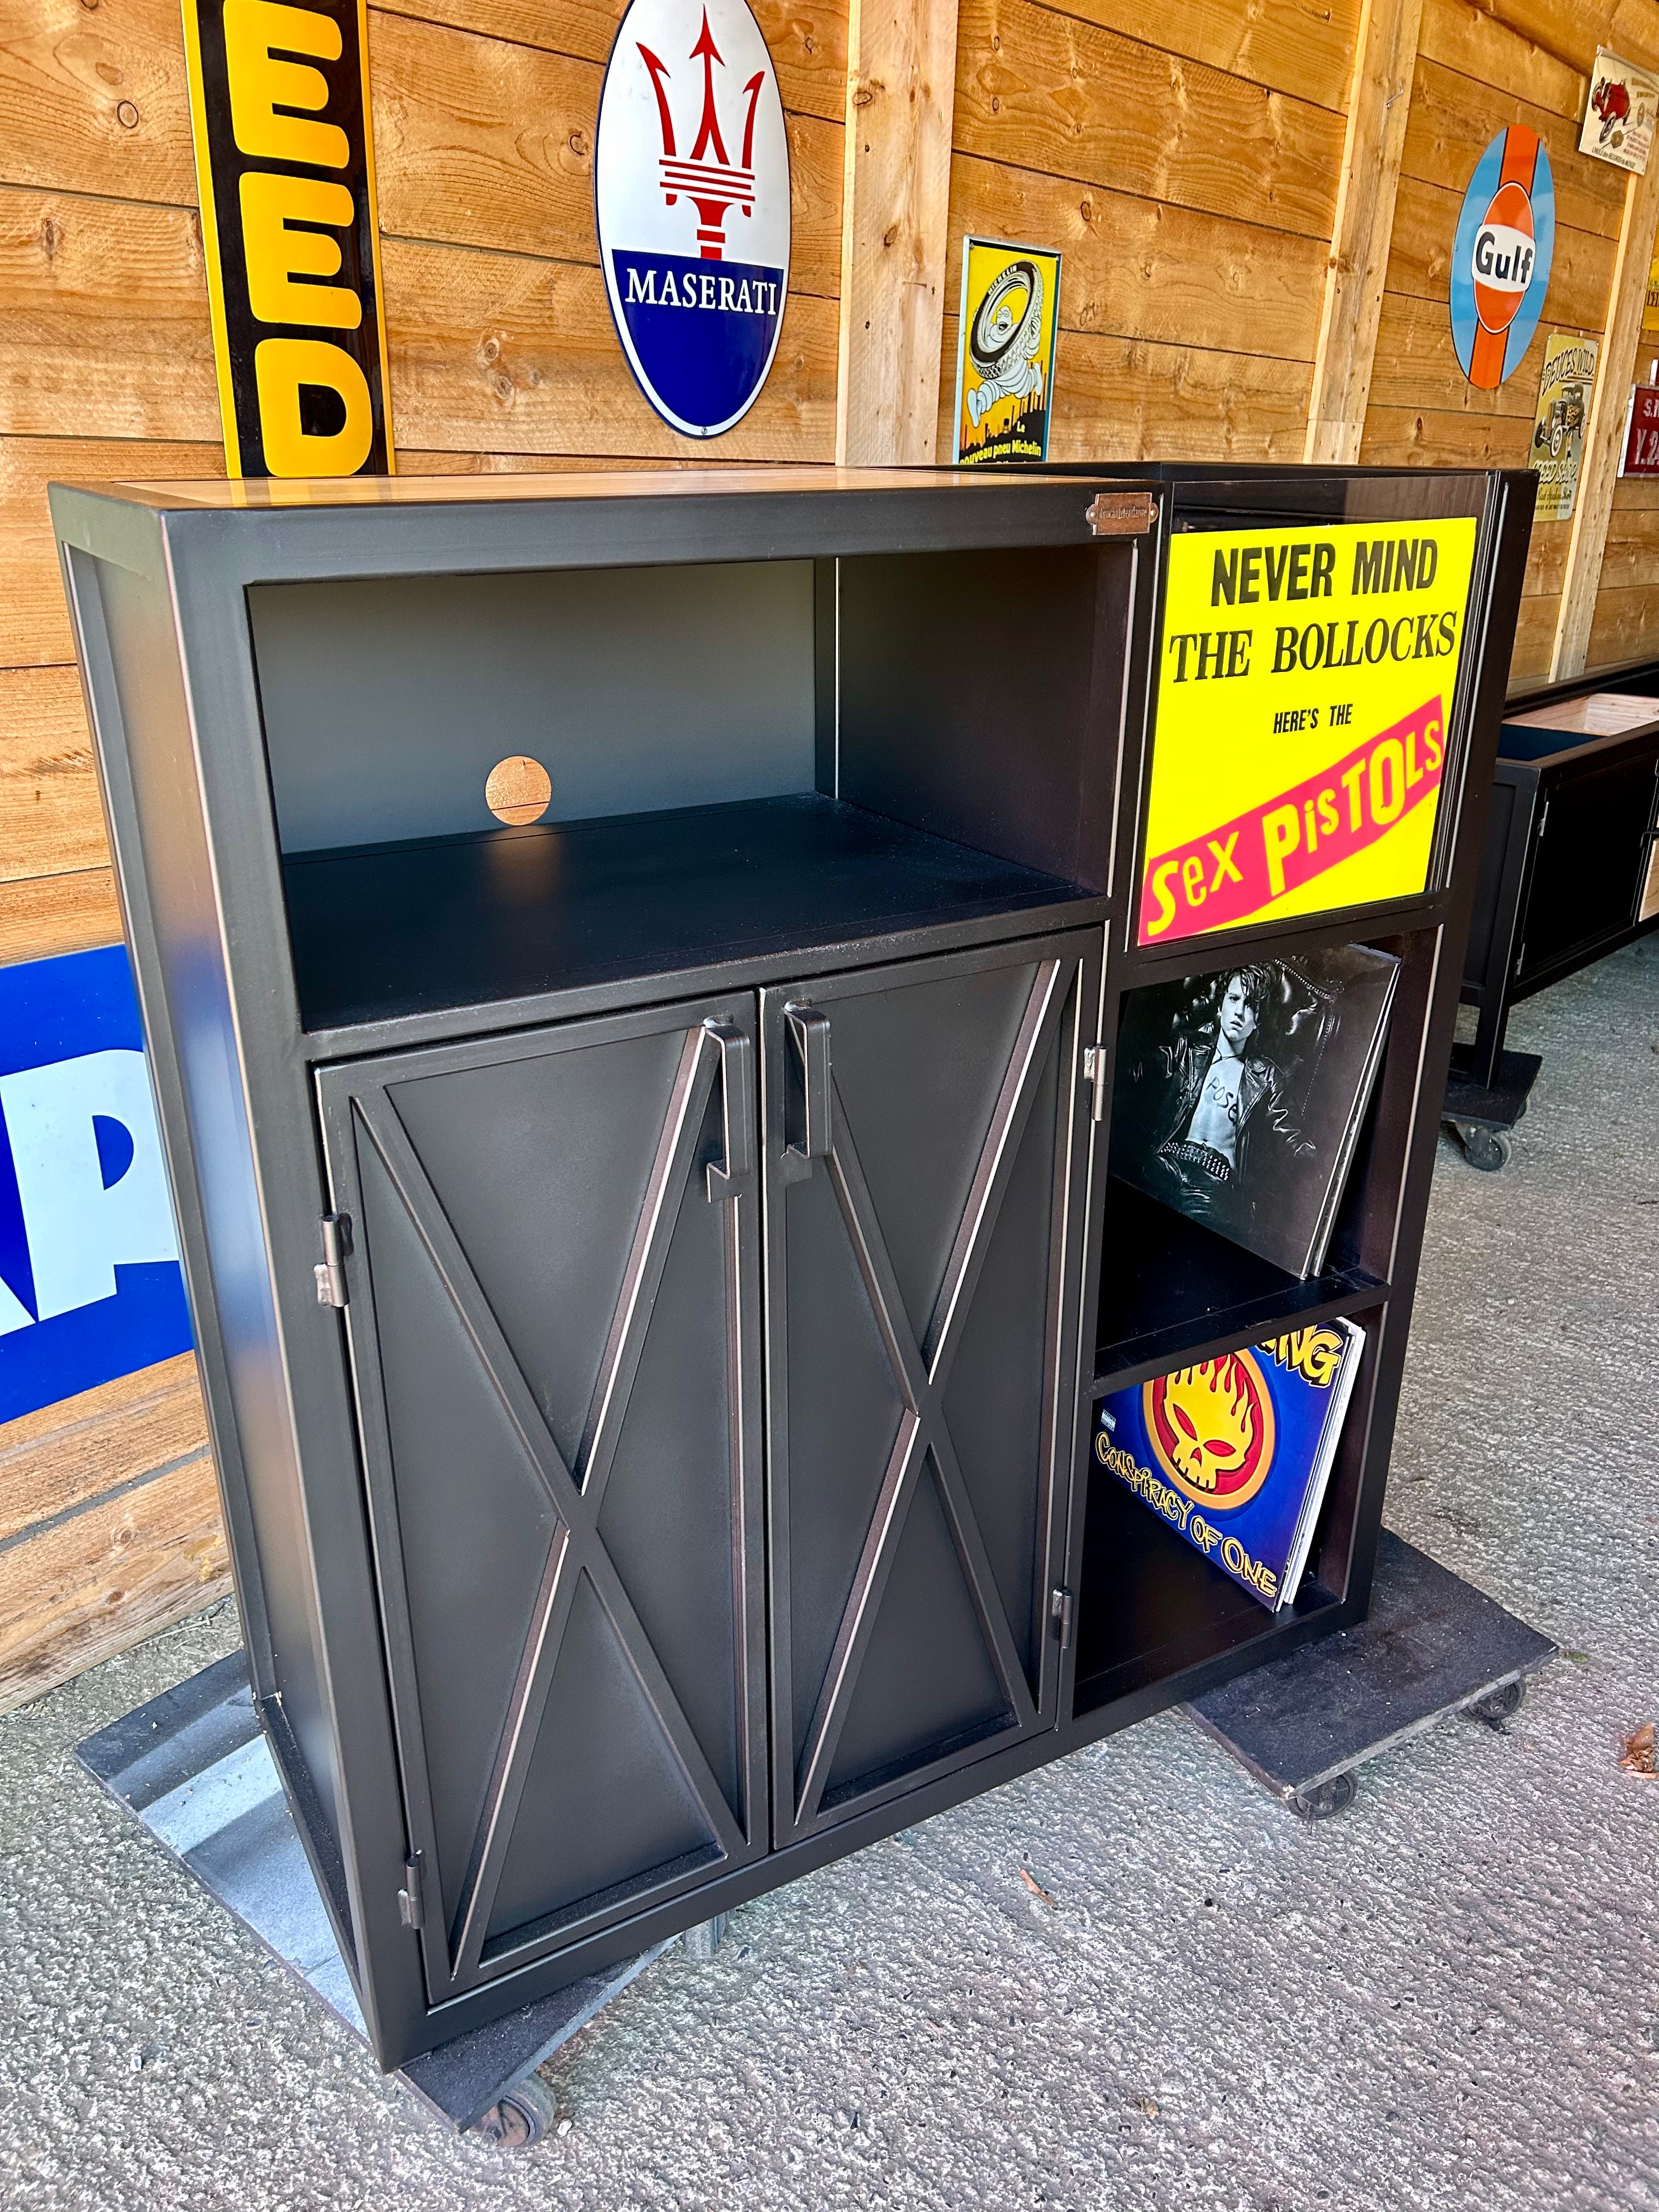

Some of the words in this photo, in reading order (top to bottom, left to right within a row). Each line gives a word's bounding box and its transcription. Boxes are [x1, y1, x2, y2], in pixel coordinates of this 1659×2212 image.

[1476, 232, 1533, 285] Gulf
[625, 267, 777, 316] MASERATI
[992, 443, 1012, 459] pneu
[1011, 439, 1042, 457] Michelin
[1016, 420, 1026, 433] Le
[1210, 543, 1336, 607] NEVER
[1351, 538, 1438, 595] MIND
[1170, 630, 1253, 683] THE
[1271, 611, 1457, 674] BOLLOCKS
[1273, 707, 1319, 734] HERE'S
[1329, 703, 1353, 726] THE
